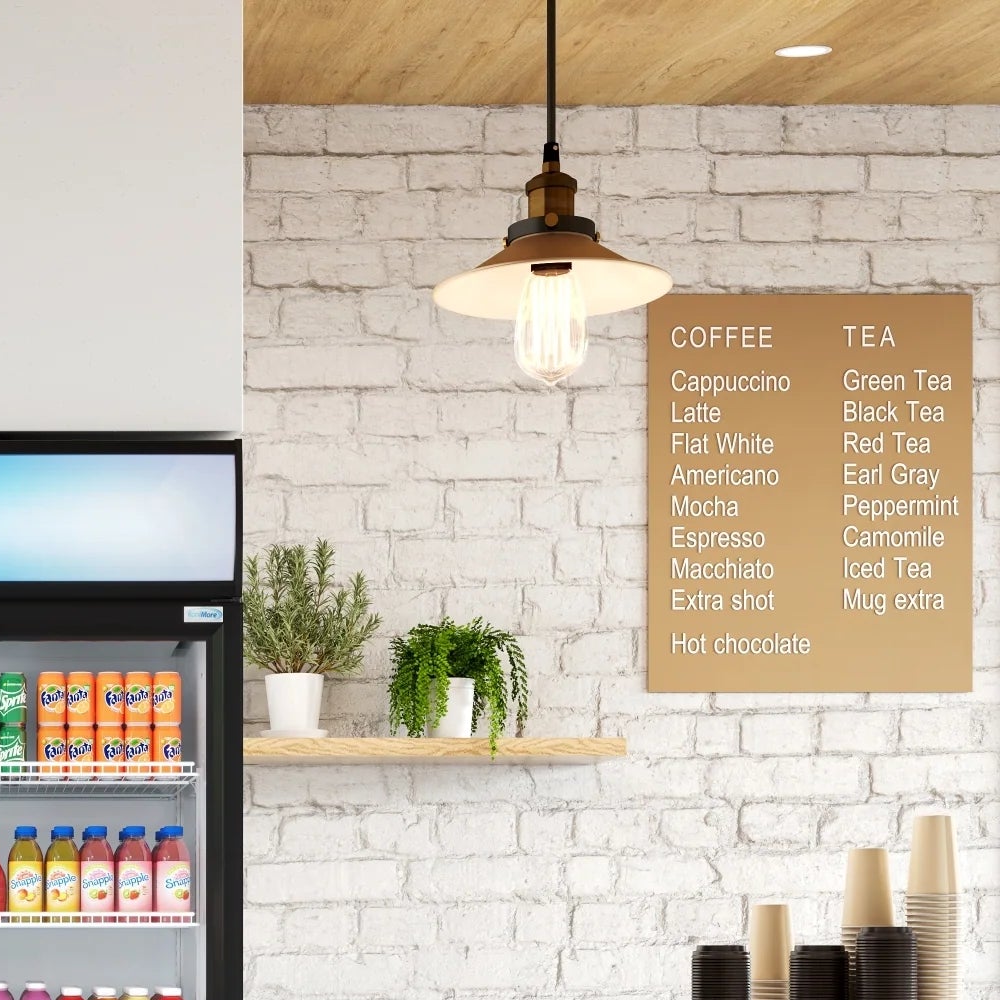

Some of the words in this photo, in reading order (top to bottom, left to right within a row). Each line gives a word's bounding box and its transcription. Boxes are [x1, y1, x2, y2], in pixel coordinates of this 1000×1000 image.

[671, 326, 773, 348] COFFEE
[842, 325, 896, 347] TEA
[671, 369, 791, 397] Cappuccino
[843, 368, 905, 391] Green
[913, 369, 952, 391] Tea
[671, 401, 721, 423] Latte
[843, 400, 899, 422] Black
[905, 400, 945, 422] Tea
[671, 432, 709, 455] Flat
[716, 432, 774, 455] White
[843, 431, 884, 454] Red
[891, 431, 931, 454] Tea
[670, 463, 779, 486] Americano
[843, 463, 883, 485] Earl
[891, 462, 940, 491] Gray
[671, 495, 739, 517] Mocha
[843, 494, 959, 521] Peppermint
[671, 526, 766, 553] Espresso
[843, 525, 945, 548] Camomile
[671, 557, 774, 580] Macchiato
[843, 557, 885, 579] Iced
[893, 556, 932, 579] Tea
[671, 588, 724, 611] Extra
[731, 589, 775, 611] shot
[843, 588, 887, 616] Mug
[894, 589, 945, 610] extra
[671, 632, 707, 655] Hot
[714, 632, 811, 655] chocolate
[10, 873, 42, 890] Snapple
